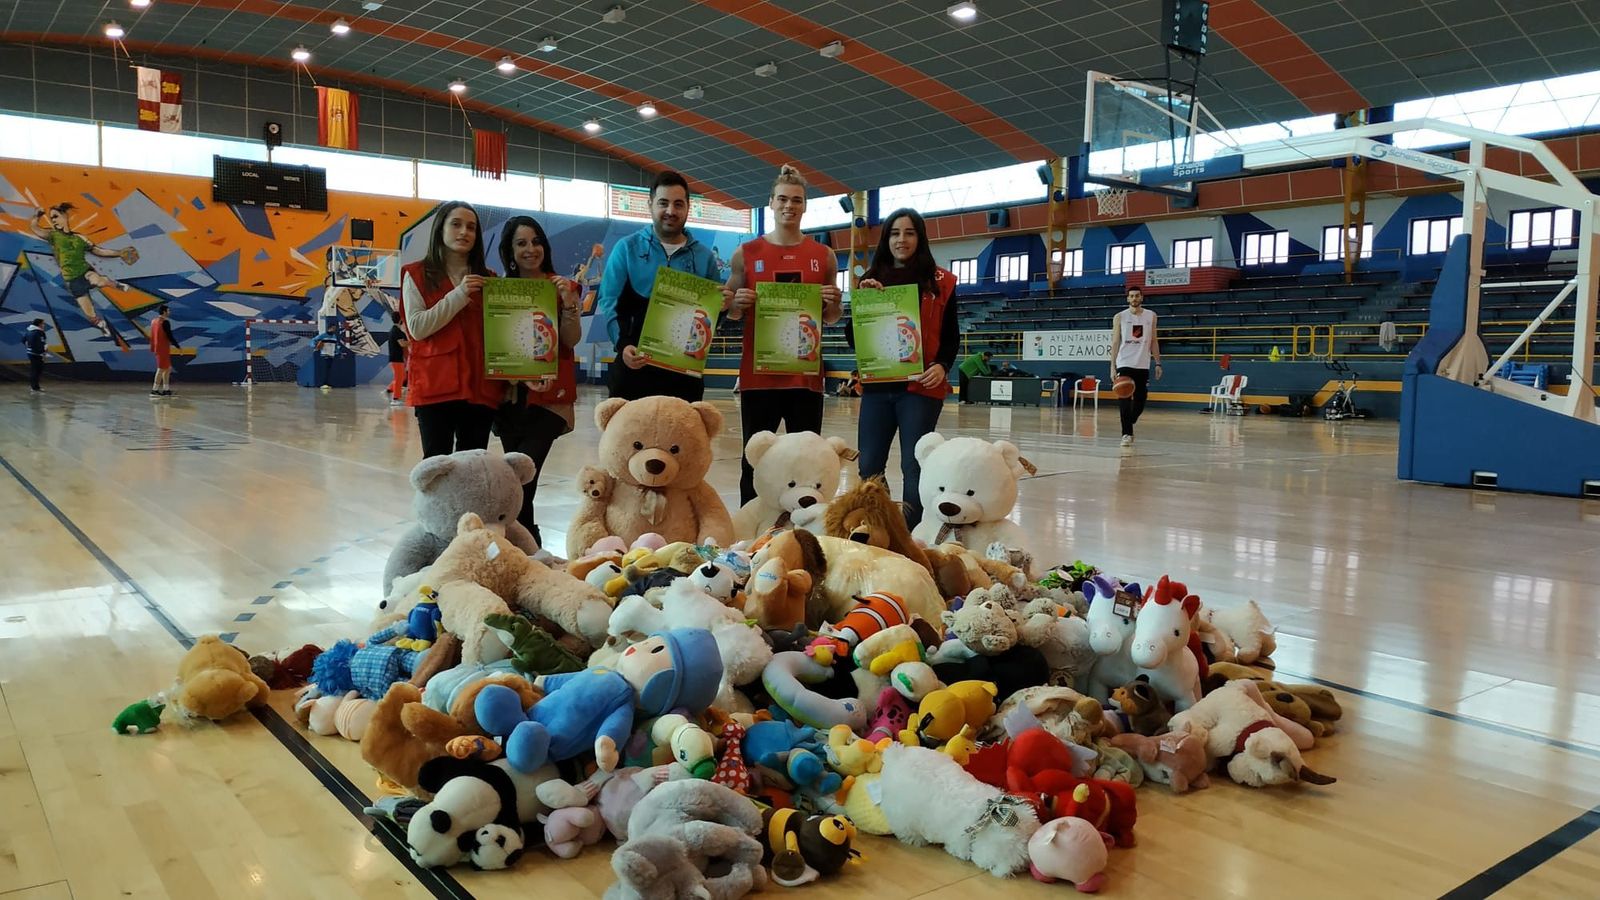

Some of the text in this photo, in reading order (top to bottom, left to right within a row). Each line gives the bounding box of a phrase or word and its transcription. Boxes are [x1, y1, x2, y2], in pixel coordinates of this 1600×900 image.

[1172, 167, 1205, 177] Sports
[810, 258, 820, 272] 13
[1050, 333, 1113, 342] AYUNTAMIENT
[1049, 344, 1113, 356] DE ZAMOR
